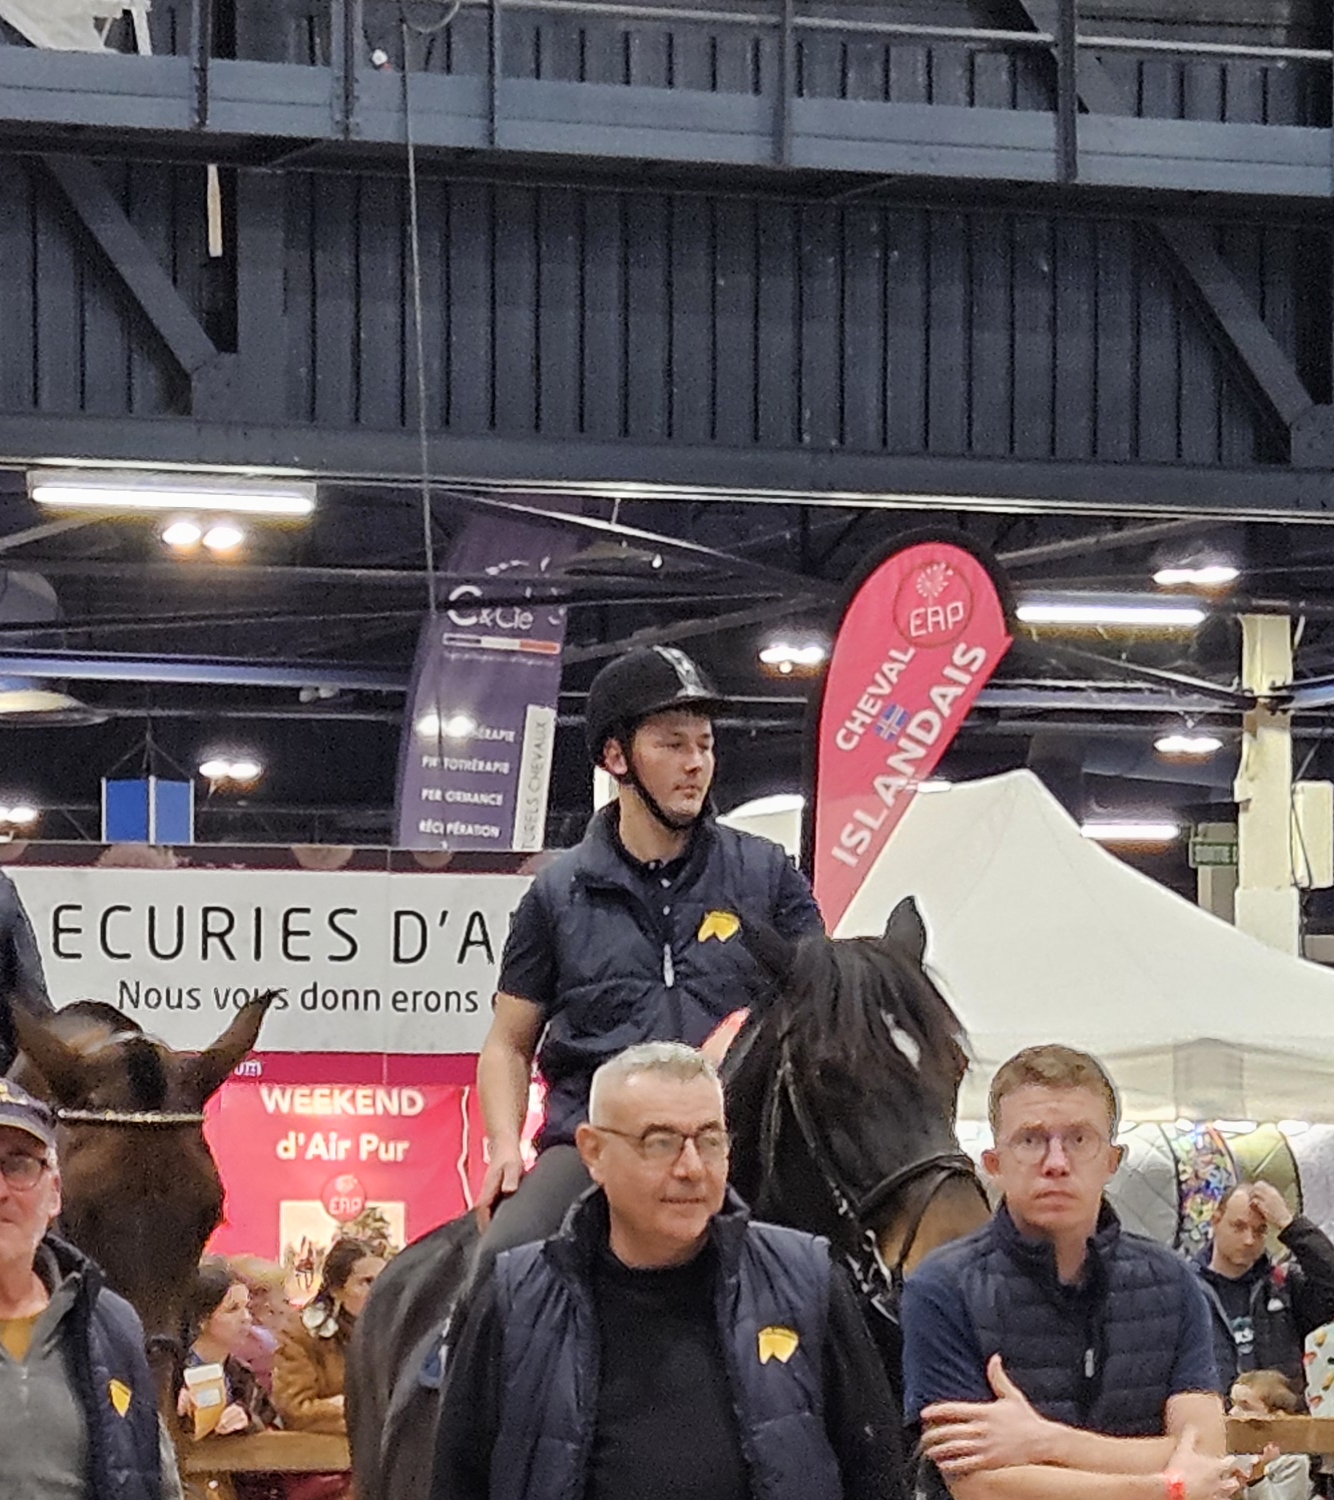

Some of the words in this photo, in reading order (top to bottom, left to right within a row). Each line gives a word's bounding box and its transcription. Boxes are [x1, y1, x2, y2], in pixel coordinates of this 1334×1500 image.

[835, 646, 916, 752] CHEVAL
[421, 754, 510, 775] PHTOTHÉRAPIE
[831, 642, 987, 868] ISLANDAIS
[421, 788, 504, 806] PERORMANCE
[52, 904, 359, 962] ECURIES
[392, 909, 513, 965] D'A
[118, 980, 201, 1011] Nous
[260, 1087, 425, 1117] WEEKEND
[275, 1131, 352, 1161] d'Air
[359, 1133, 411, 1162] Pur
